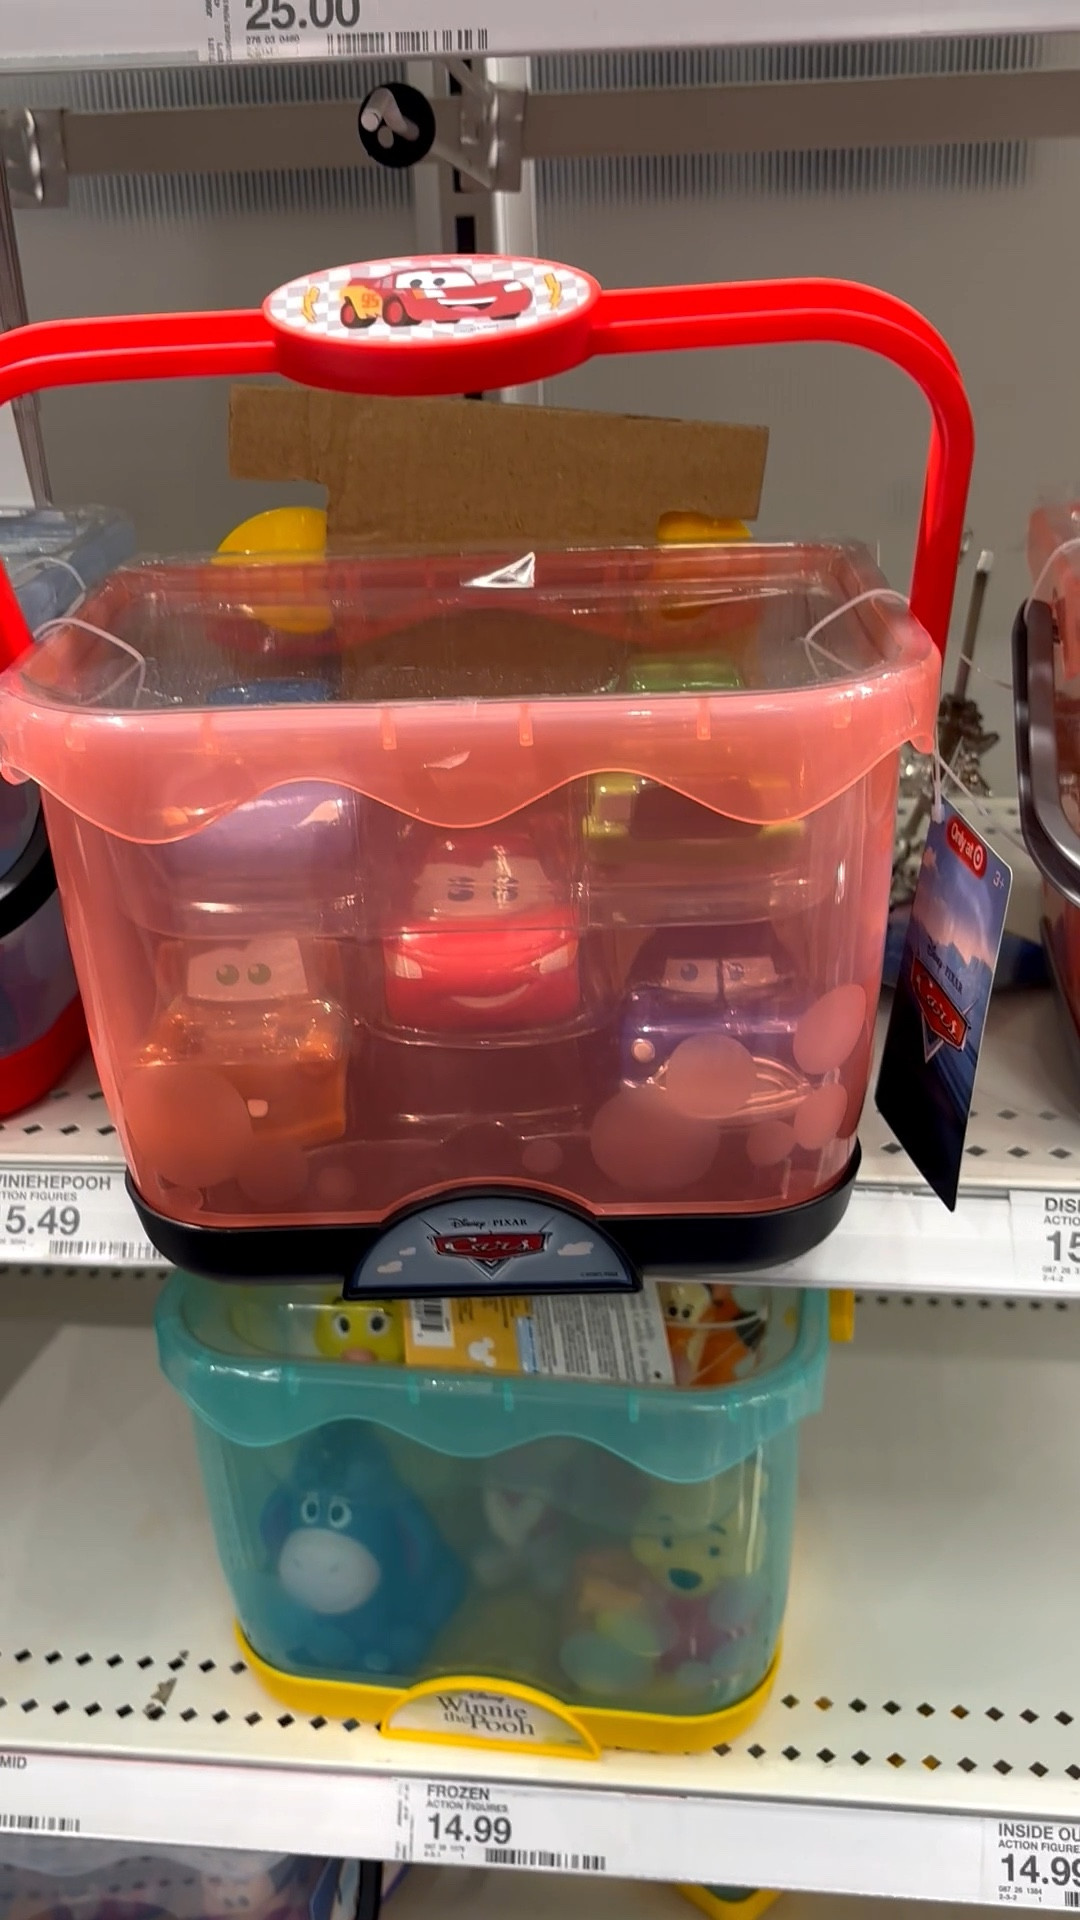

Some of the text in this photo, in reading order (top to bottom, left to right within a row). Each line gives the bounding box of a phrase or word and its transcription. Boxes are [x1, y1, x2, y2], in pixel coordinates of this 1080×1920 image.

[246, 0, 360, 30] 25.00
[362, 293, 379, 308] 95
[951, 822, 975, 860] Only at
[993, 870, 1005, 889] 3+
[0, 1174, 111, 1190] INIEHEPOOH
[30, 1191, 77, 1202] FIGURES
[1045, 1197, 1080, 1213] DIS
[6, 1206, 80, 1236] 5.49
[448, 1217, 528, 1230] Disney PIXAR
[436, 1695, 528, 1719] Winnie
[443, 1711, 535, 1736] the Pooh
[427, 1784, 490, 1801] FROZEN
[426, 1799, 508, 1813] ACTION FIGURES
[428, 1813, 512, 1845] 14.99
[999, 1823, 1053, 1840] INSIDE
[998, 1840, 1038, 1850] ACTION
